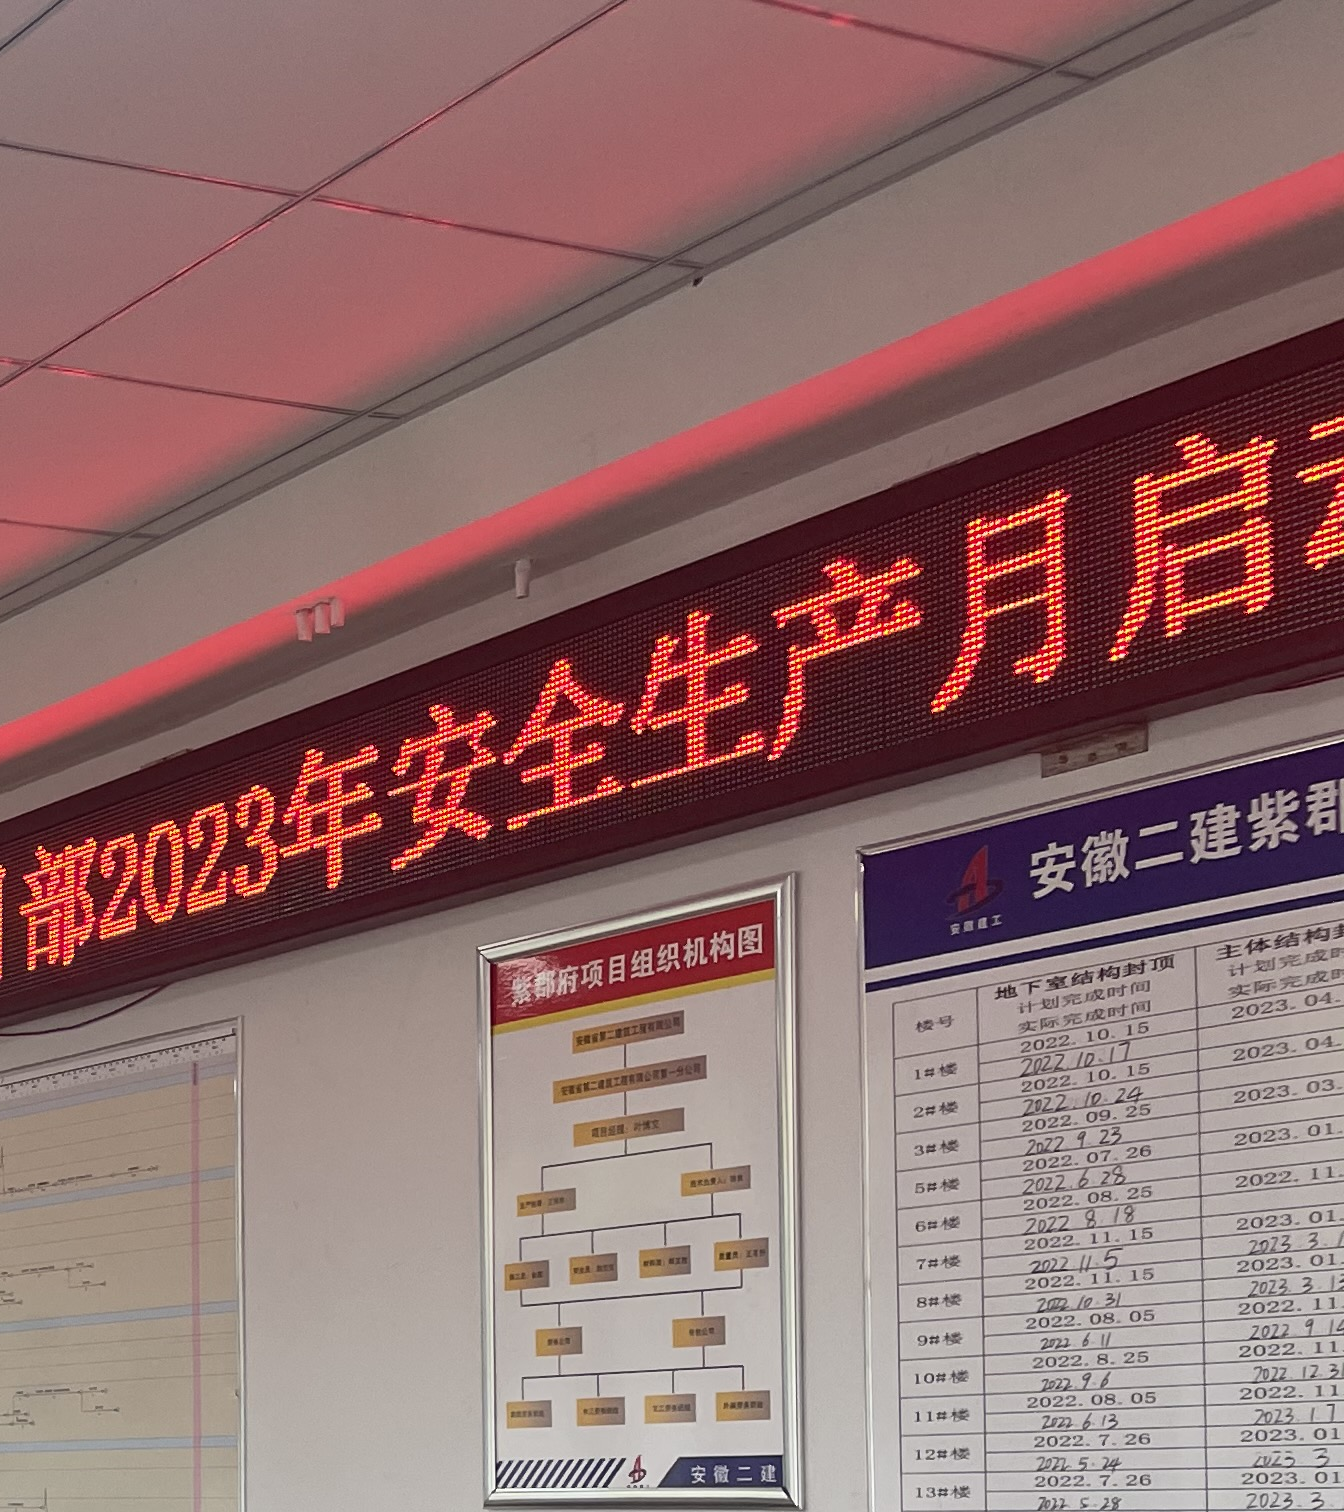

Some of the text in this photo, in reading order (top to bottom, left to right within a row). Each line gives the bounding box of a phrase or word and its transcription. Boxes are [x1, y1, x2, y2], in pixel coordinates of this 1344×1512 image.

[511, 923, 764, 1007] 紫郡府项目组织机构图
[994, 954, 1176, 1000] 地下室结构封顶
[1018, 980, 1151, 1014] 计划完成时间
[915, 1015, 955, 1033] 楼号
[1018, 1000, 1151, 1033] 实际完成时间
[914, 1063, 957, 1081] 1#楼
[913, 1102, 959, 1118] 2#楼
[914, 1140, 959, 1156] 3#楼
[915, 1178, 960, 1194] 5#楼
[915, 1216, 960, 1232] 6#楼
[916, 1254, 961, 1270] 7#楼
[916, 1293, 962, 1308] 8#楼
[917, 1332, 963, 1347] 9#楼
[914, 1369, 969, 1384] 10#楼
[914, 1407, 970, 1422] 11#楼
[915, 1446, 970, 1461] 12#楼
[690, 1464, 777, 1485] 安徽二建
[915, 1485, 971, 1499] 13#楼
